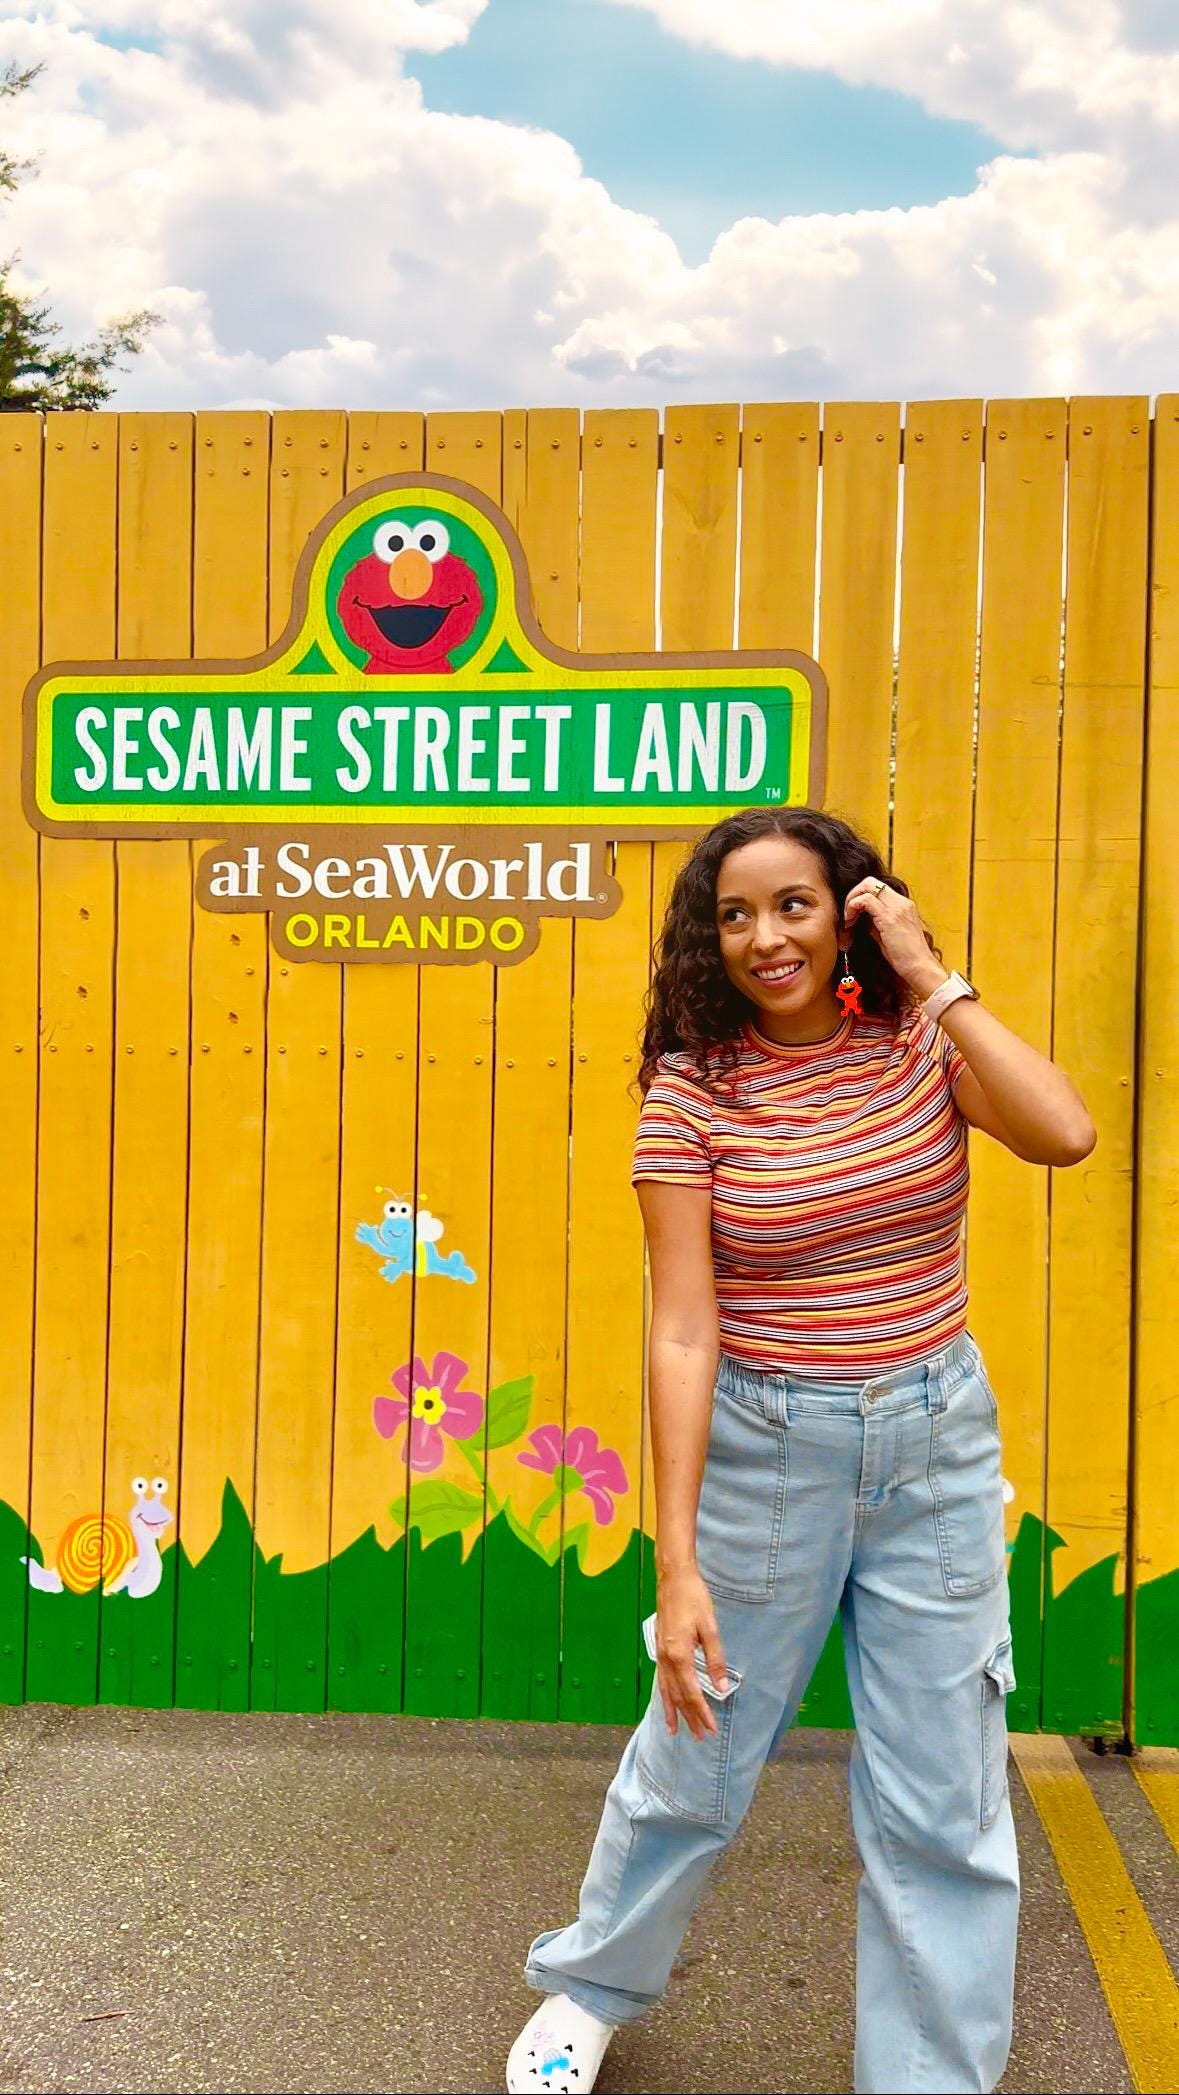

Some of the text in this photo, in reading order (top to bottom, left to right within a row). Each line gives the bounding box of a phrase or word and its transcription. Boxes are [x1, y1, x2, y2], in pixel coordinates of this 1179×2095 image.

[74, 706, 312, 792] SESAME
[336, 705, 572, 793] STREET
[593, 701, 767, 792] LAND
[209, 847, 265, 897] at
[276, 843, 595, 902] SeaWorld
[285, 913, 525, 952] ORLANDO
